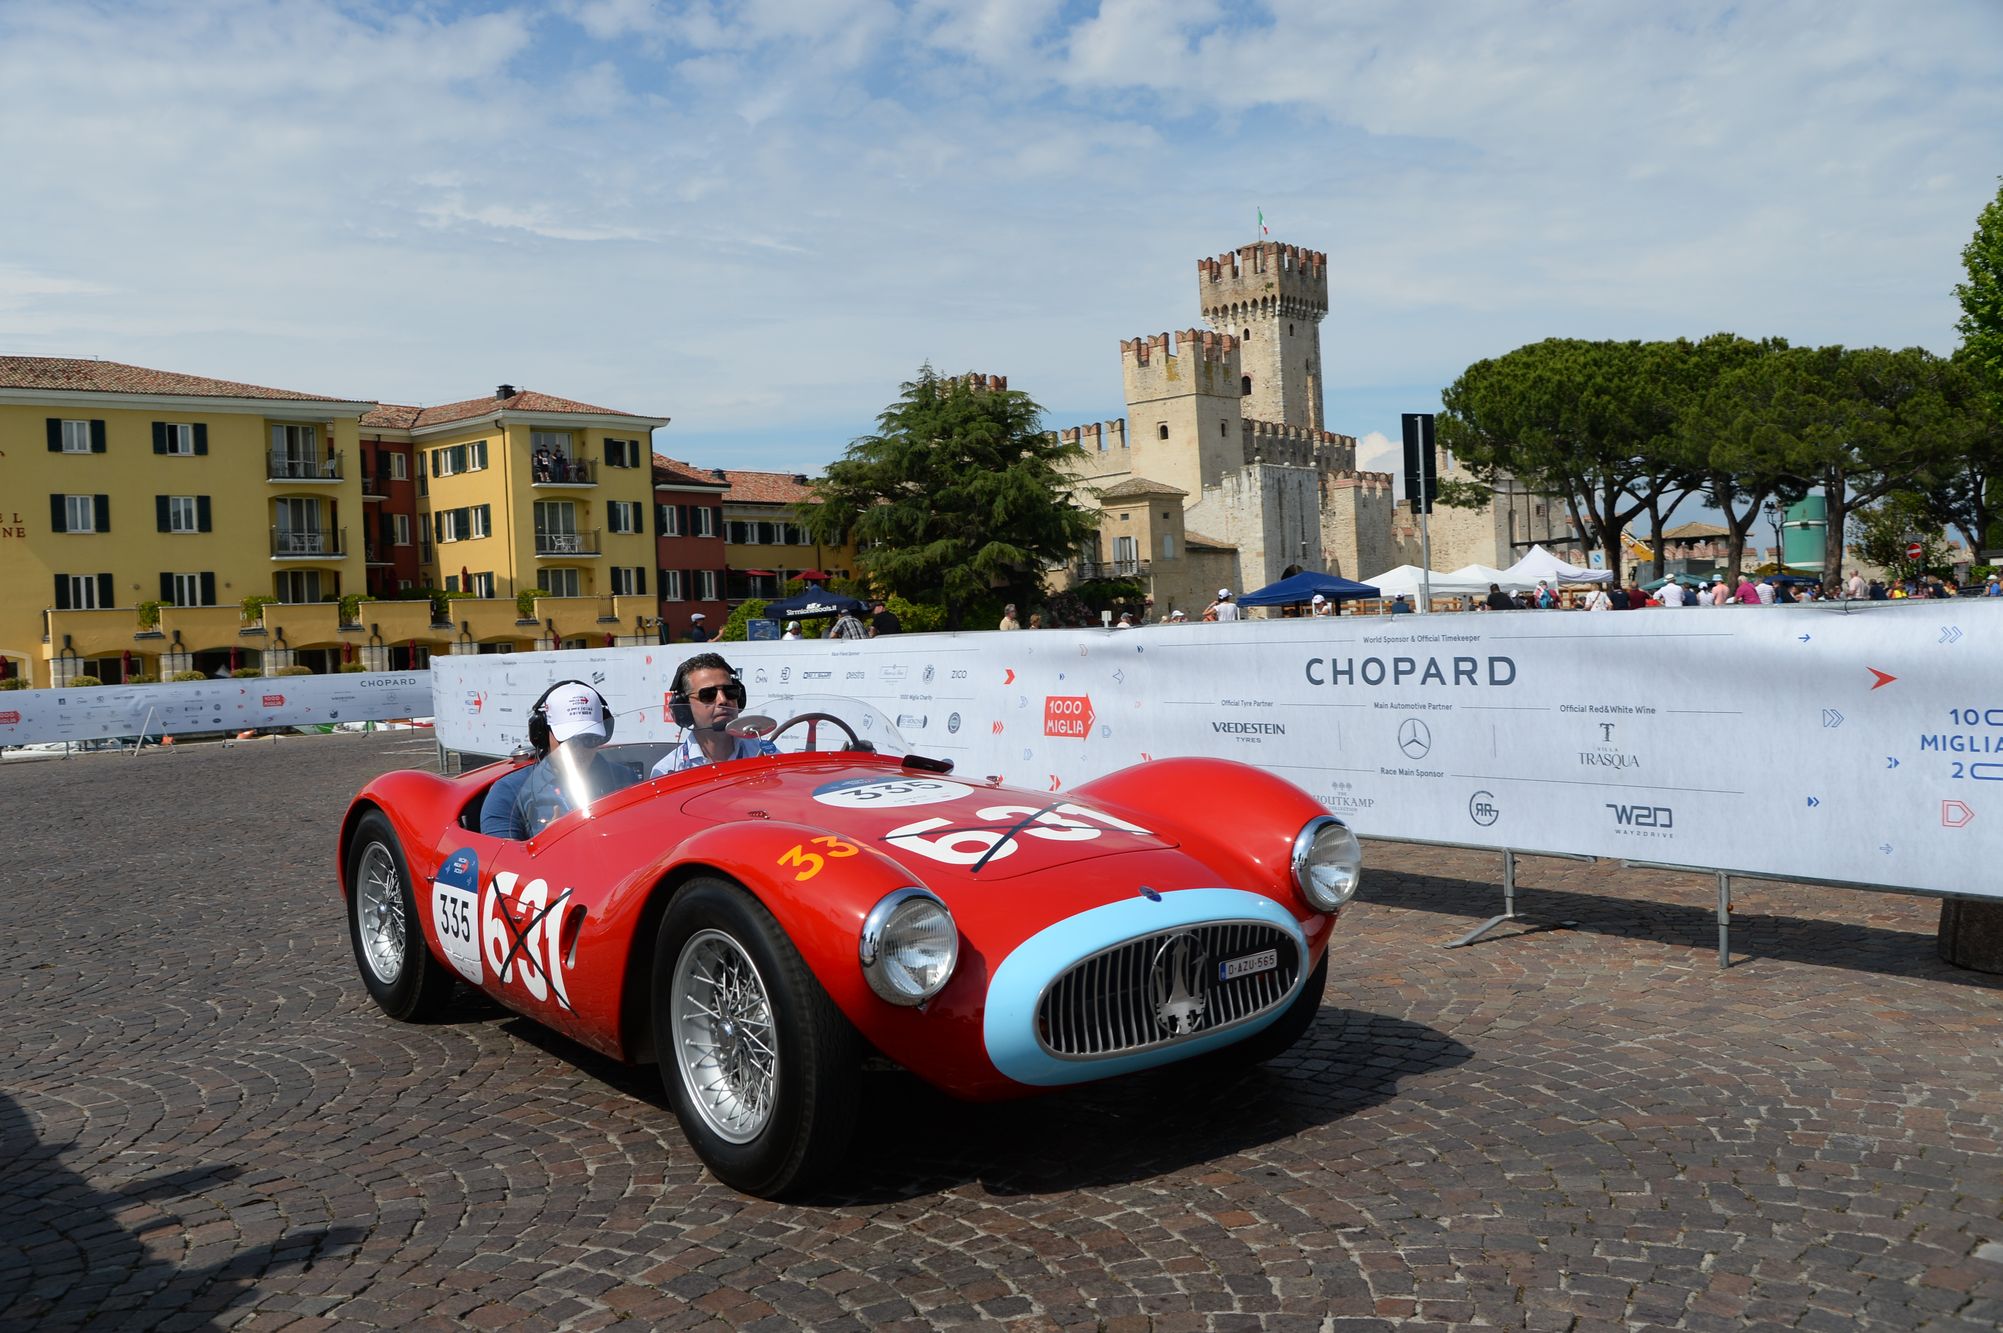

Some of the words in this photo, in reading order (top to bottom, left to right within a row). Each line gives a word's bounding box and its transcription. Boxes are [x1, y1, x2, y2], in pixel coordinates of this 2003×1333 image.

[1363, 635, 1381, 643] World
[1383, 635, 1409, 645] Sponsor
[1411, 635, 1416, 643] &
[1417, 634, 1440, 643] Official
[1441, 634, 1481, 643] Timekeeper
[951, 670, 968, 679] ZICO
[1306, 656, 1517, 686] CHOPARD
[360, 678, 417, 688] CHOPARD
[1049, 700, 1082, 714] 1000
[1221, 699, 1240, 707] Official
[1241, 699, 1252, 708] Tyre
[1253, 699, 1273, 707] Partner
[1374, 702, 1388, 710] Main
[1390, 702, 1426, 710] Automotive
[1428, 702, 1453, 710] Partner
[1560, 704, 1587, 713] Official
[1589, 705, 1633, 714] Red&White
[1635, 706, 1656, 714] Wine
[1046, 719, 1084, 734] MIGLIA
[1212, 721, 1286, 735] VREDESTEIN
[1236, 736, 1262, 744] TYRES
[1578, 752, 1640, 770] TRASQUA
[1380, 767, 1397, 775] Race
[1398, 768, 1414, 776] Main
[1416, 768, 1444, 778] Sponsor
[840, 781, 943, 800] 335
[1615, 829, 1674, 839] WAY2DRIVE
[440, 893, 471, 943] 335
[483, 871, 571, 1011] 631
